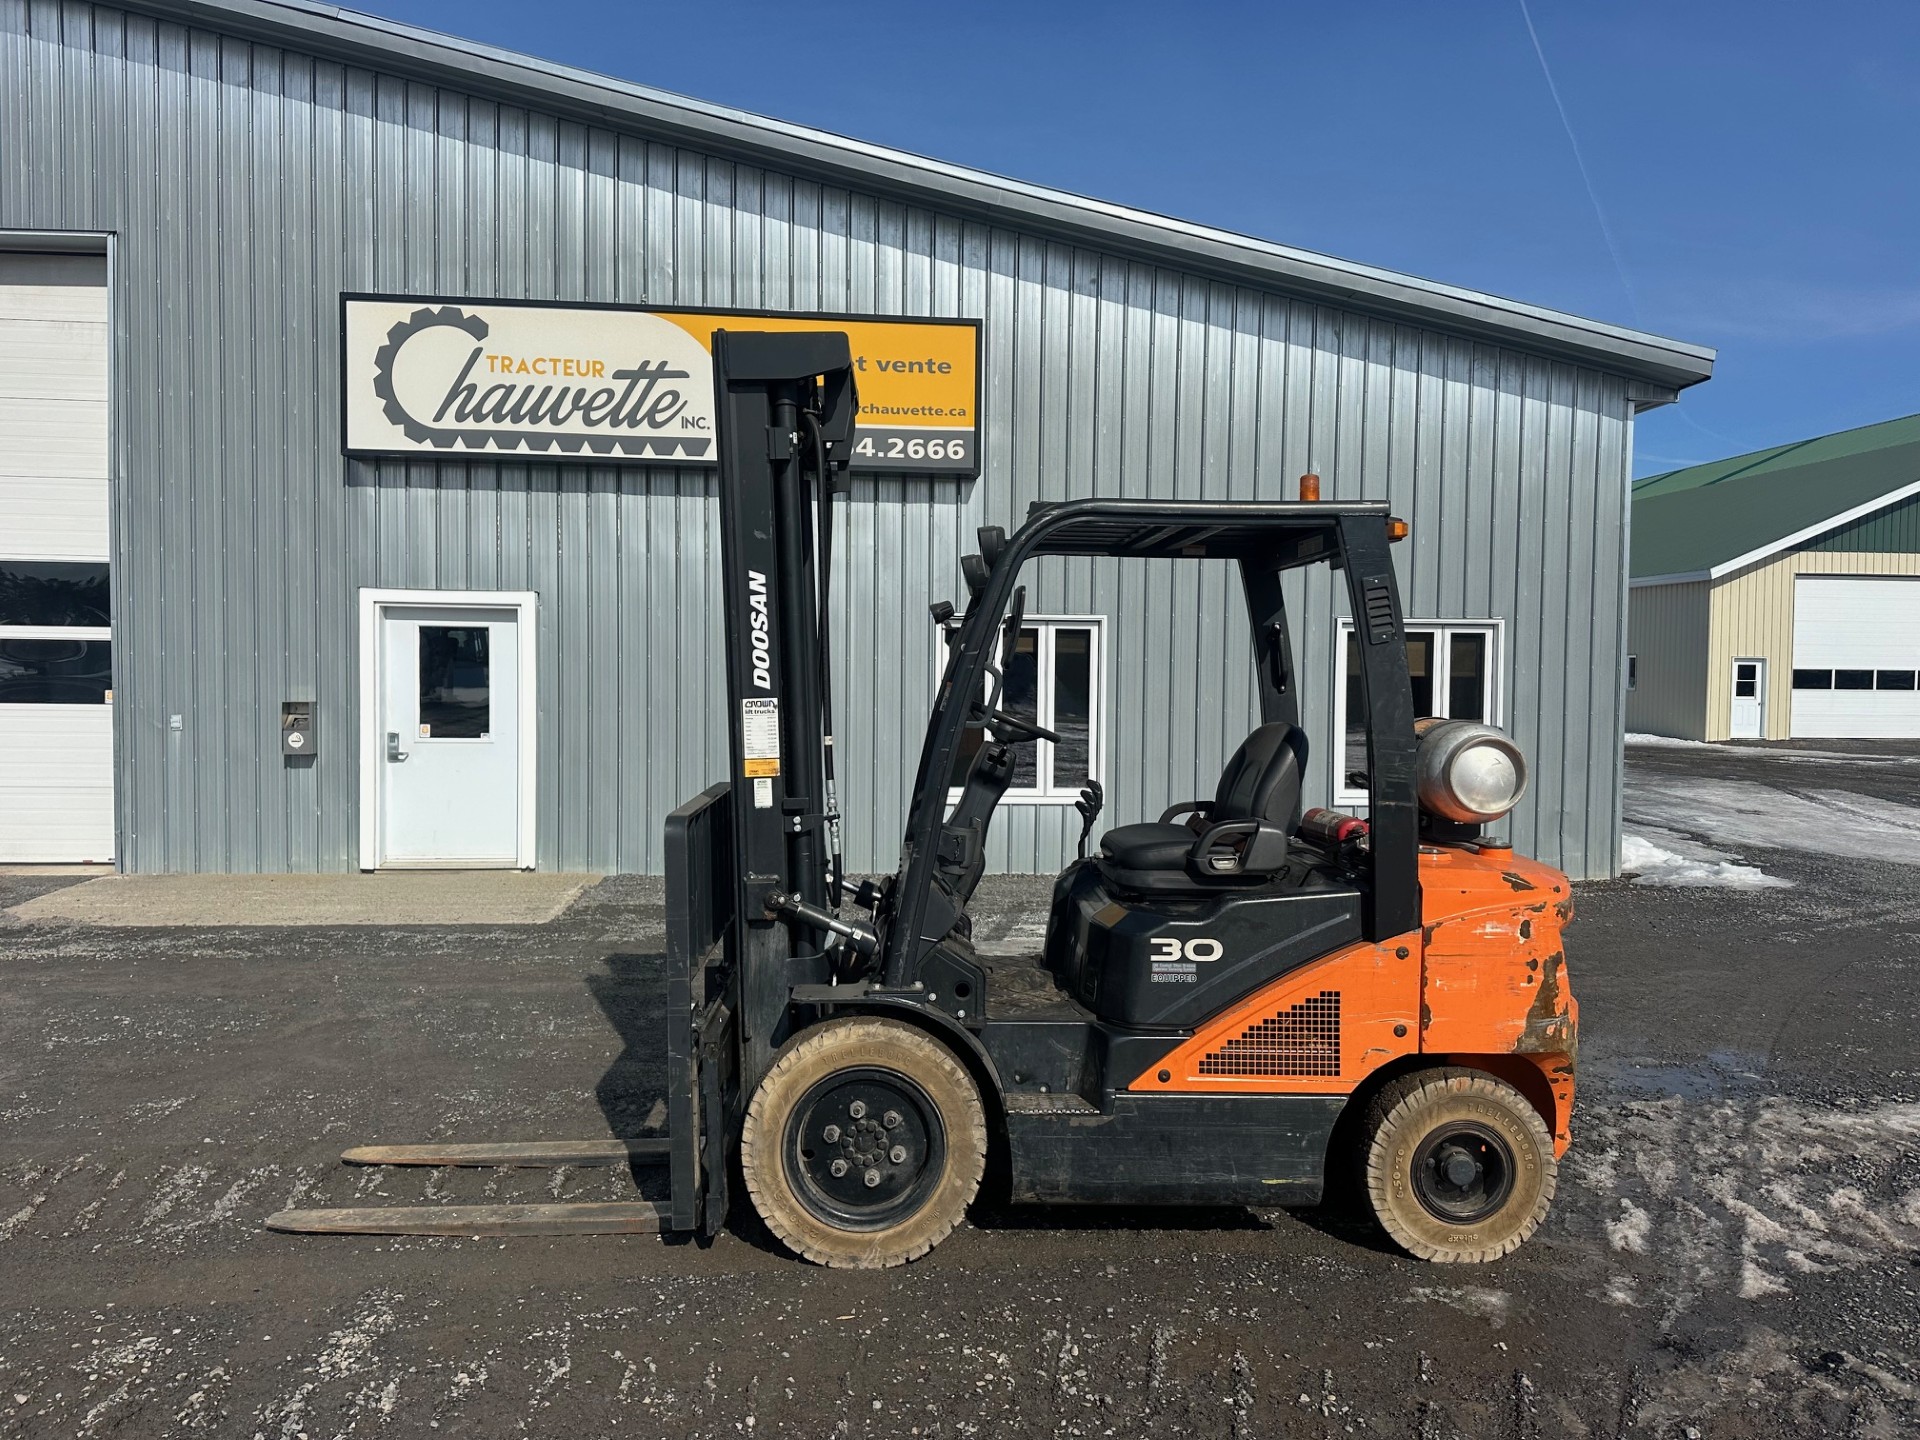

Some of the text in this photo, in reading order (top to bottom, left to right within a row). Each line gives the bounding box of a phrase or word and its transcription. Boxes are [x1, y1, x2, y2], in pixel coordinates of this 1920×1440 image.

[373, 306, 711, 444] Chauvette INC.
[485, 355, 605, 378] TRACTEUR
[852, 355, 952, 374] t vente
[851, 437, 965, 460] 4.2666
[748, 569, 771, 690] DOOSAN
[1150, 937, 1224, 962] 30
[1151, 973, 1198, 983] EQUIPPED
[821, 1047, 912, 1068] TRELLEBORG
[1467, 1103, 1534, 1170] TRELLEBORG
